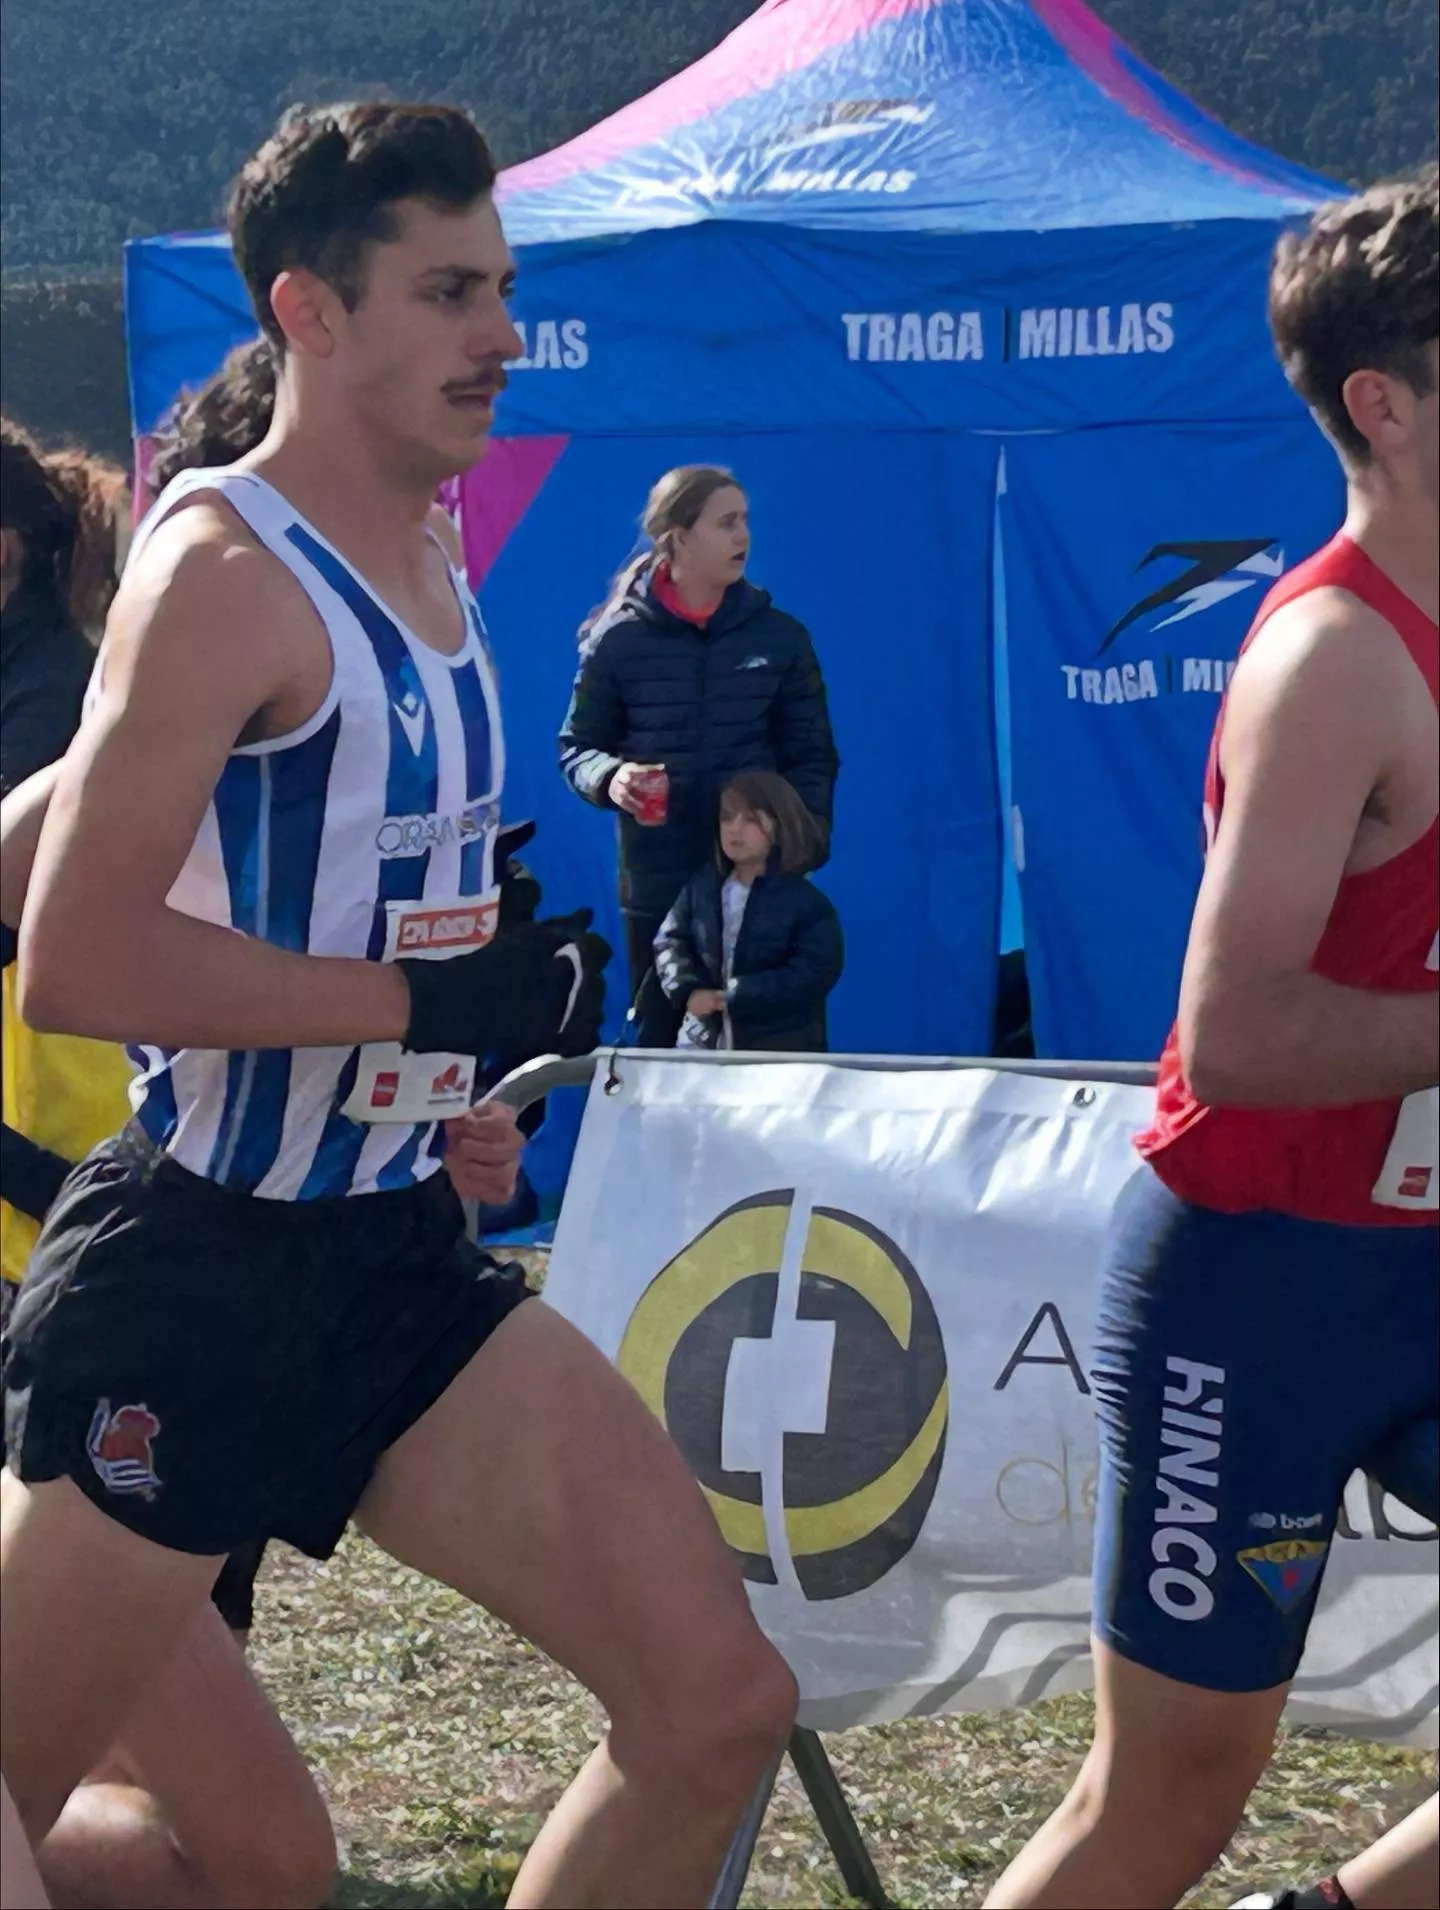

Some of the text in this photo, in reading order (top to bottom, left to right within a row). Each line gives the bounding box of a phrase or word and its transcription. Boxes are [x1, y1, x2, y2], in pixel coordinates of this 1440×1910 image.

[502, 319, 589, 370] LAS
[841, 302, 1174, 361] TRAGA MILLAS
[1061, 659, 1159, 705] TRAGA
[1147, 1355, 1227, 1622] HINACO
